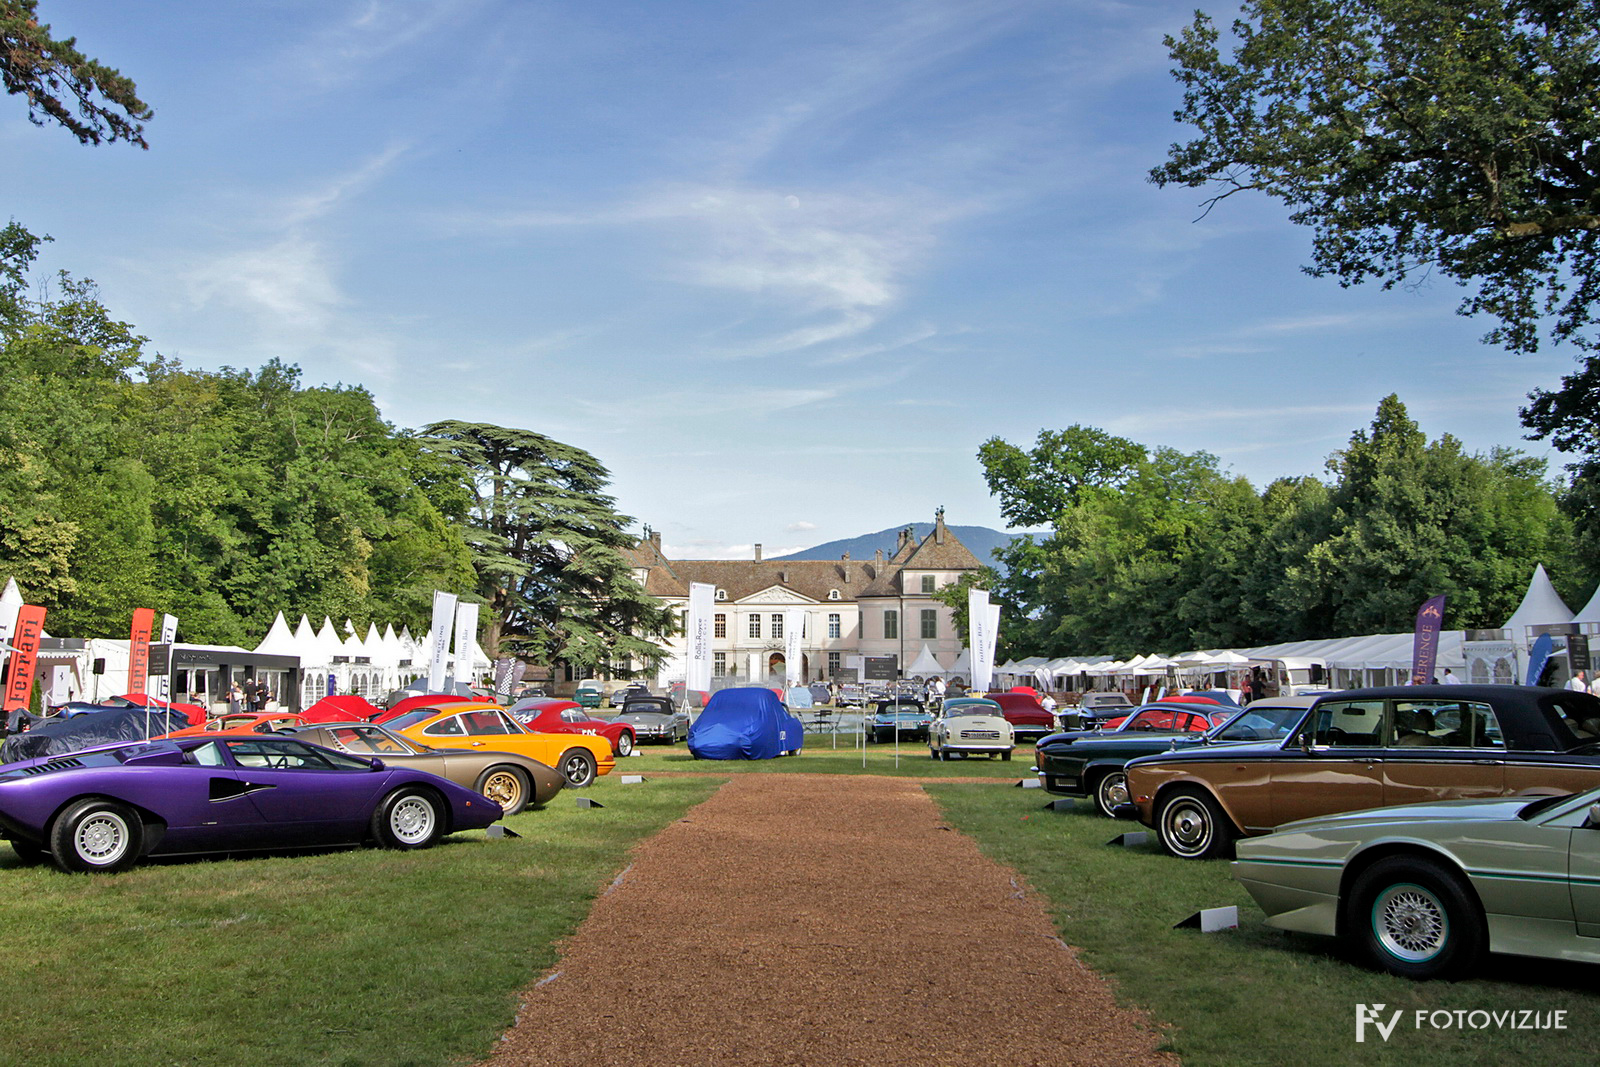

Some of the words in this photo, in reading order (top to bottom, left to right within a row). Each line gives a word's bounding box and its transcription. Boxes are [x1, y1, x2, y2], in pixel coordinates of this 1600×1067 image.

[9, 619, 38, 703] Ferrari
[133, 629, 148, 694] errari
[435, 625, 445, 664] BREITLING
[694, 618, 703, 660] Rolls-Royce
